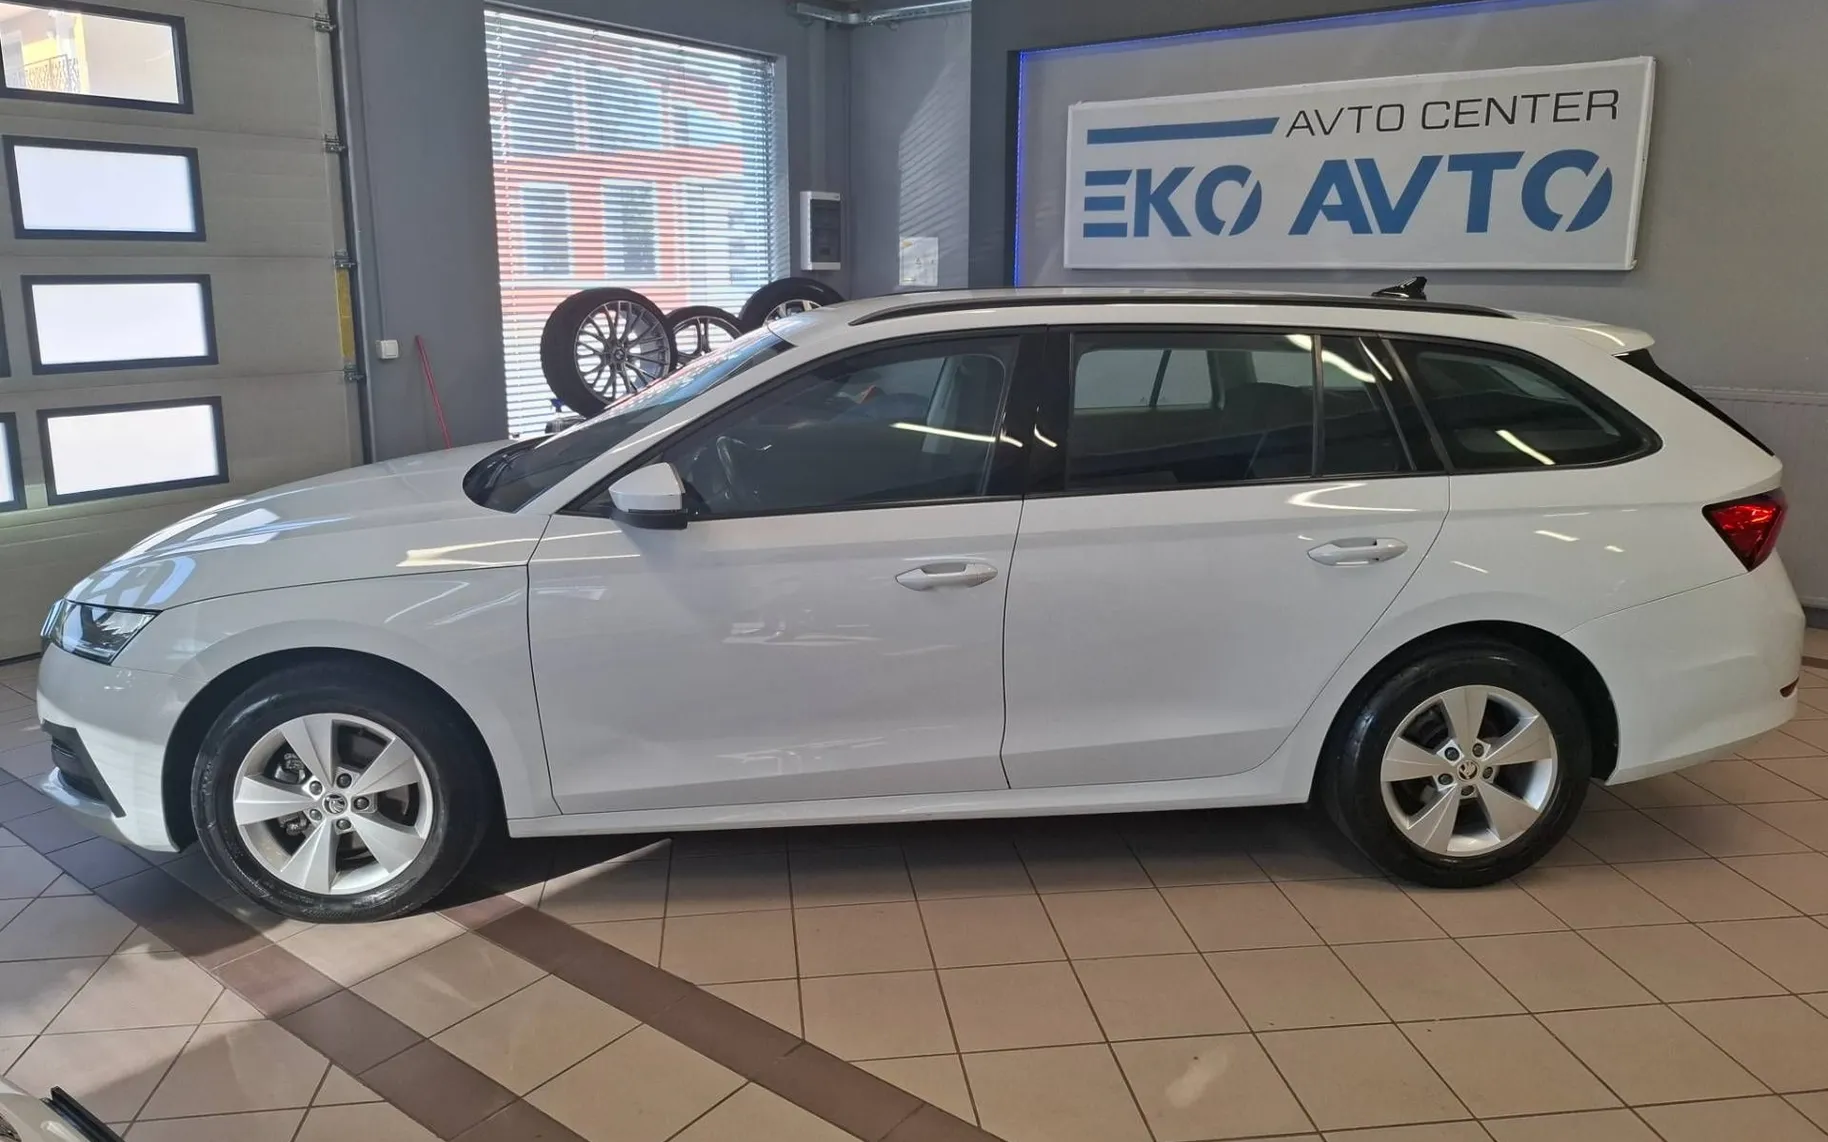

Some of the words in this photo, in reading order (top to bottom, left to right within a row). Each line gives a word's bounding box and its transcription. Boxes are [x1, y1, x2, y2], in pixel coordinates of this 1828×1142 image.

[1286, 104, 1402, 137] AVTO
[1421, 89, 1619, 130] CENTER
[1083, 164, 1262, 238] EKO
[1288, 149, 1613, 236] AVTO
